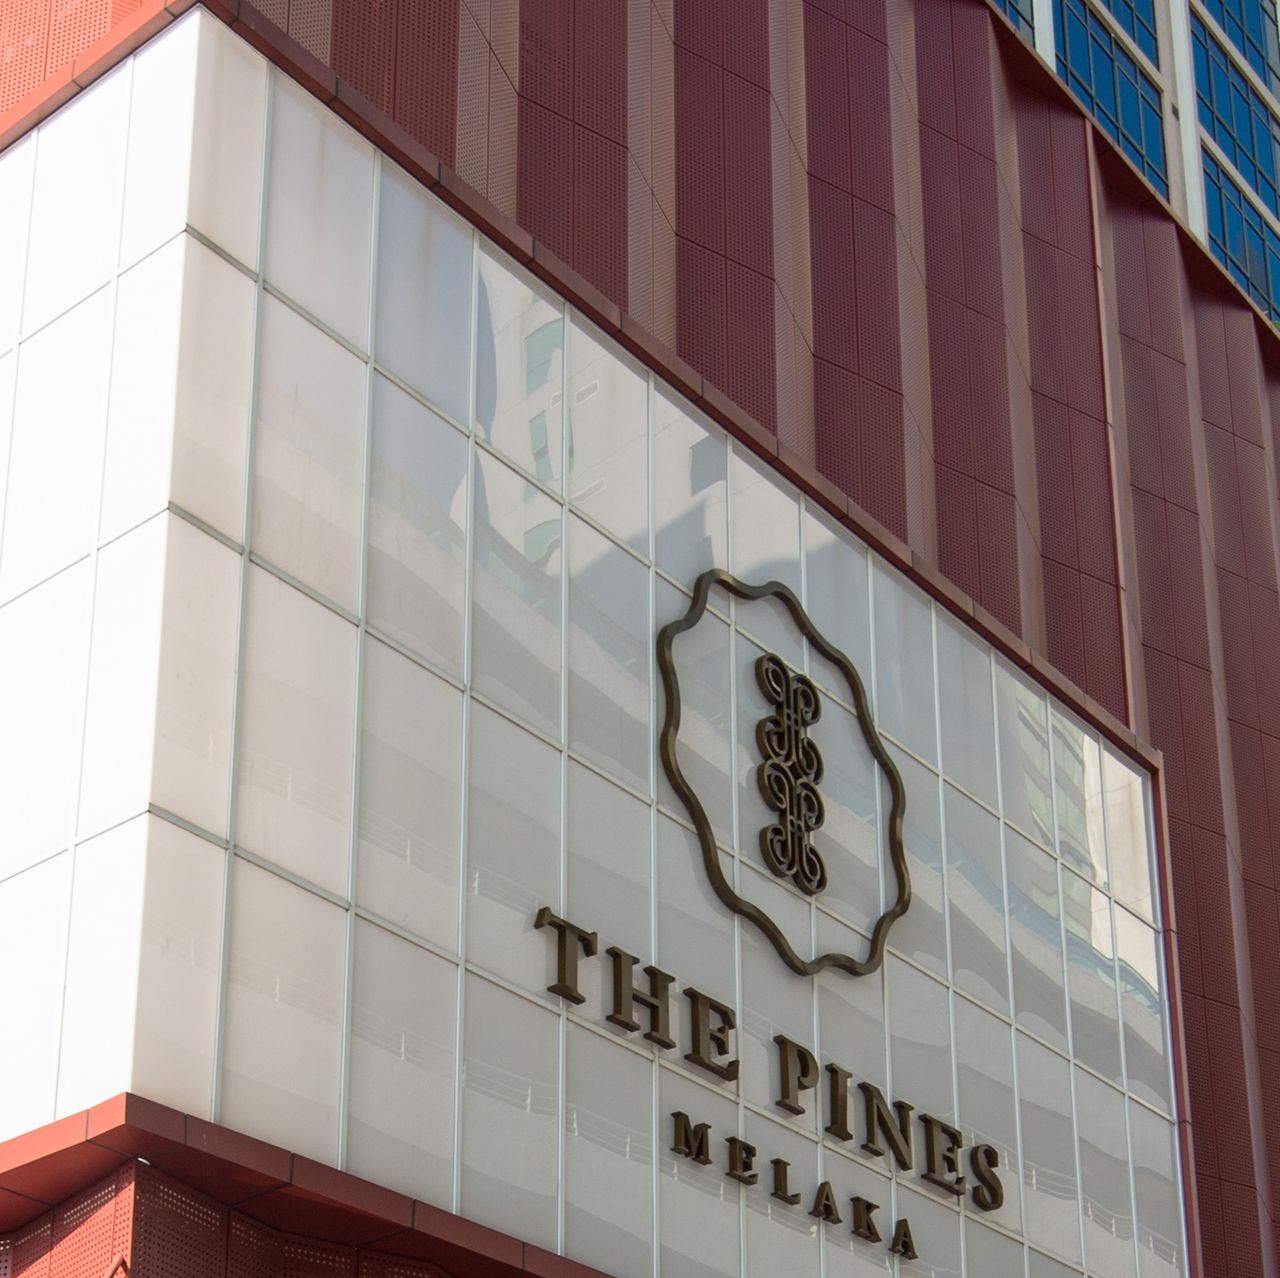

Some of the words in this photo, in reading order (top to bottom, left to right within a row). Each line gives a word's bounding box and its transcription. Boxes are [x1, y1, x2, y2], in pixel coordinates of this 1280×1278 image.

[534, 907, 740, 1082] THE
[773, 1034, 1005, 1211] PINES
[670, 1111, 919, 1260] MELAKA
